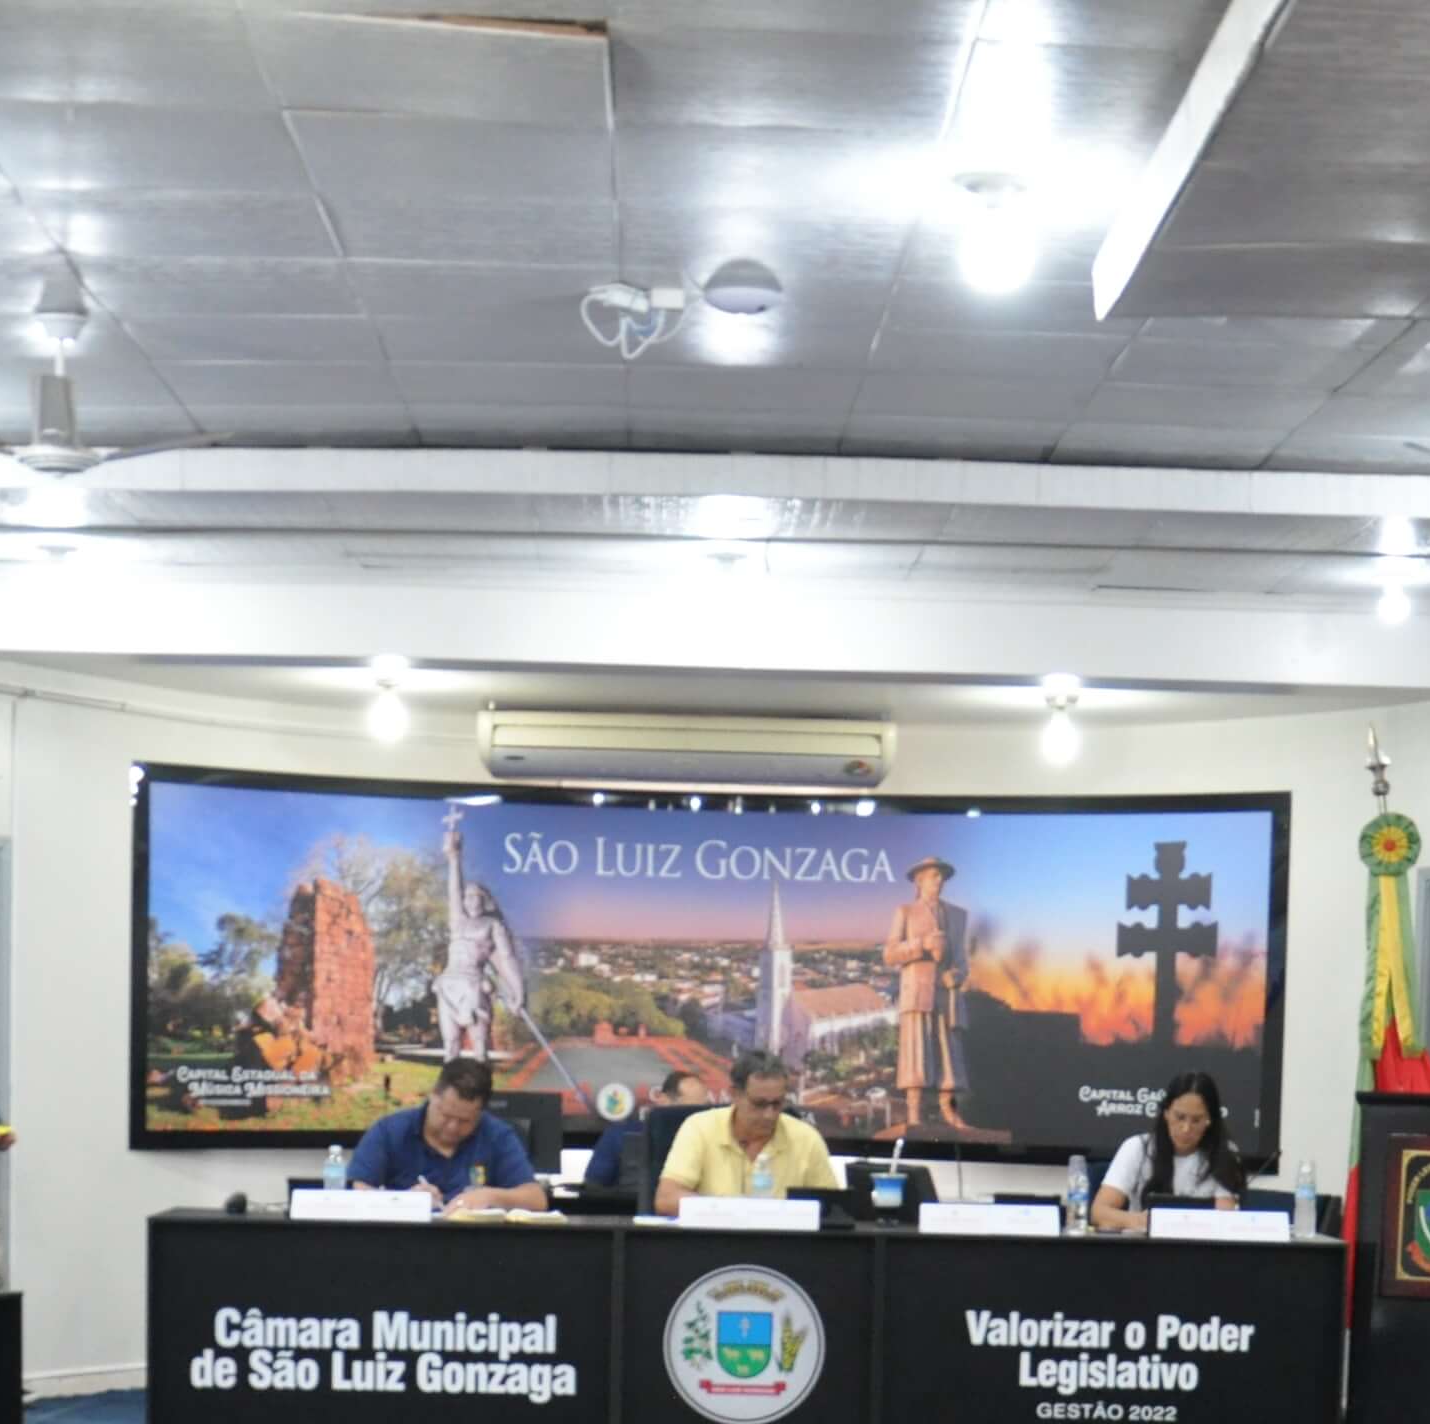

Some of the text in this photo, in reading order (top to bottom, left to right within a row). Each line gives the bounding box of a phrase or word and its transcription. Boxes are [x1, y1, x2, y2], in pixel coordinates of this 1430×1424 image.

[503, 832, 896, 883] SÃO LUIZ GONZAGA
[214, 1307, 557, 1361] Câmara Municipal
[965, 1309, 1255, 1353] Valorizar o Poder
[190, 1348, 577, 1404] de São Luiz Gonzaga
[1019, 1350, 1199, 1396] Legislativo
[1036, 1401, 1178, 1422] GESTÃO 2022
